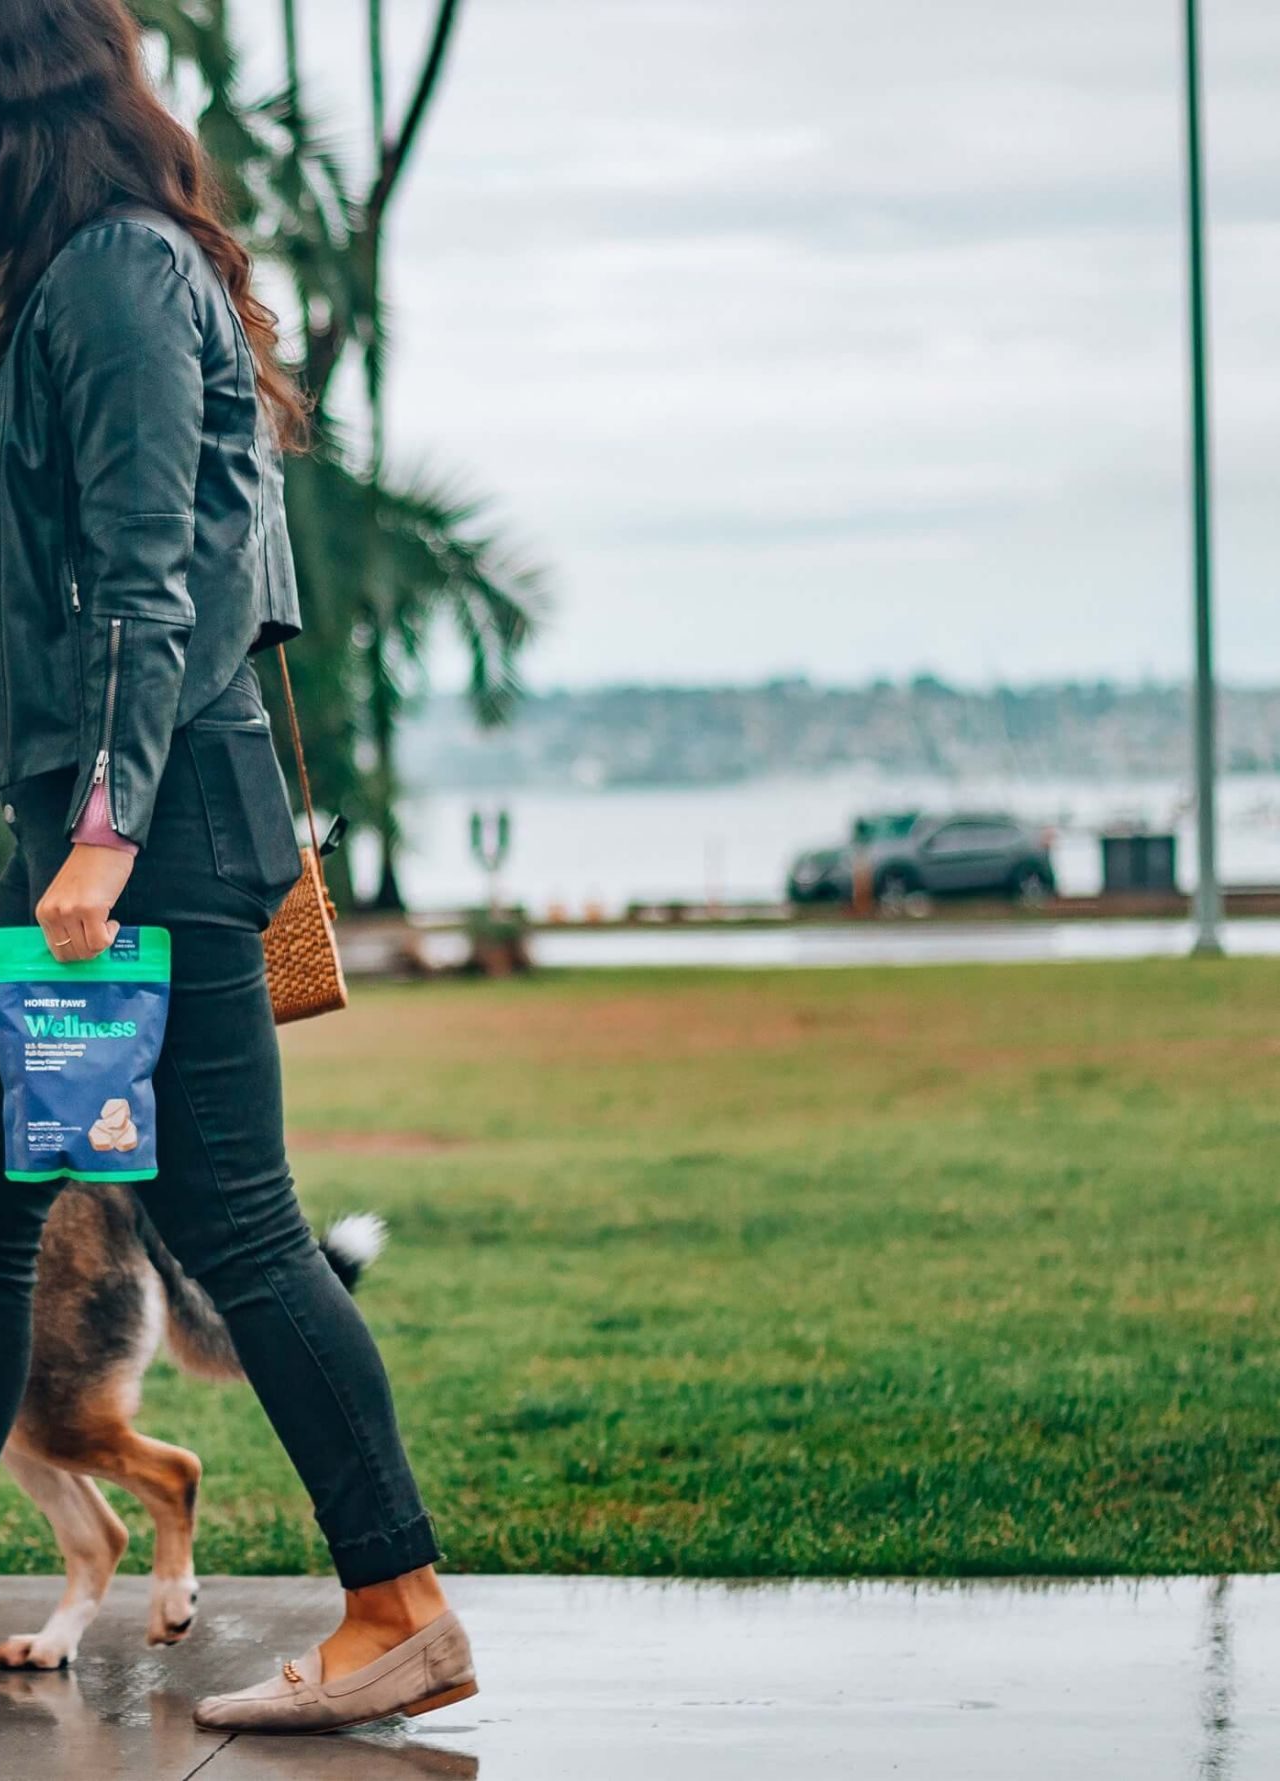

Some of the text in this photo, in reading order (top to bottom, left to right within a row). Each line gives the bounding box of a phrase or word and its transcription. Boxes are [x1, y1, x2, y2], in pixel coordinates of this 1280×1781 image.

[24, 999, 86, 1008] HONEST PAWS
[23, 1014, 137, 1038] Wellness
